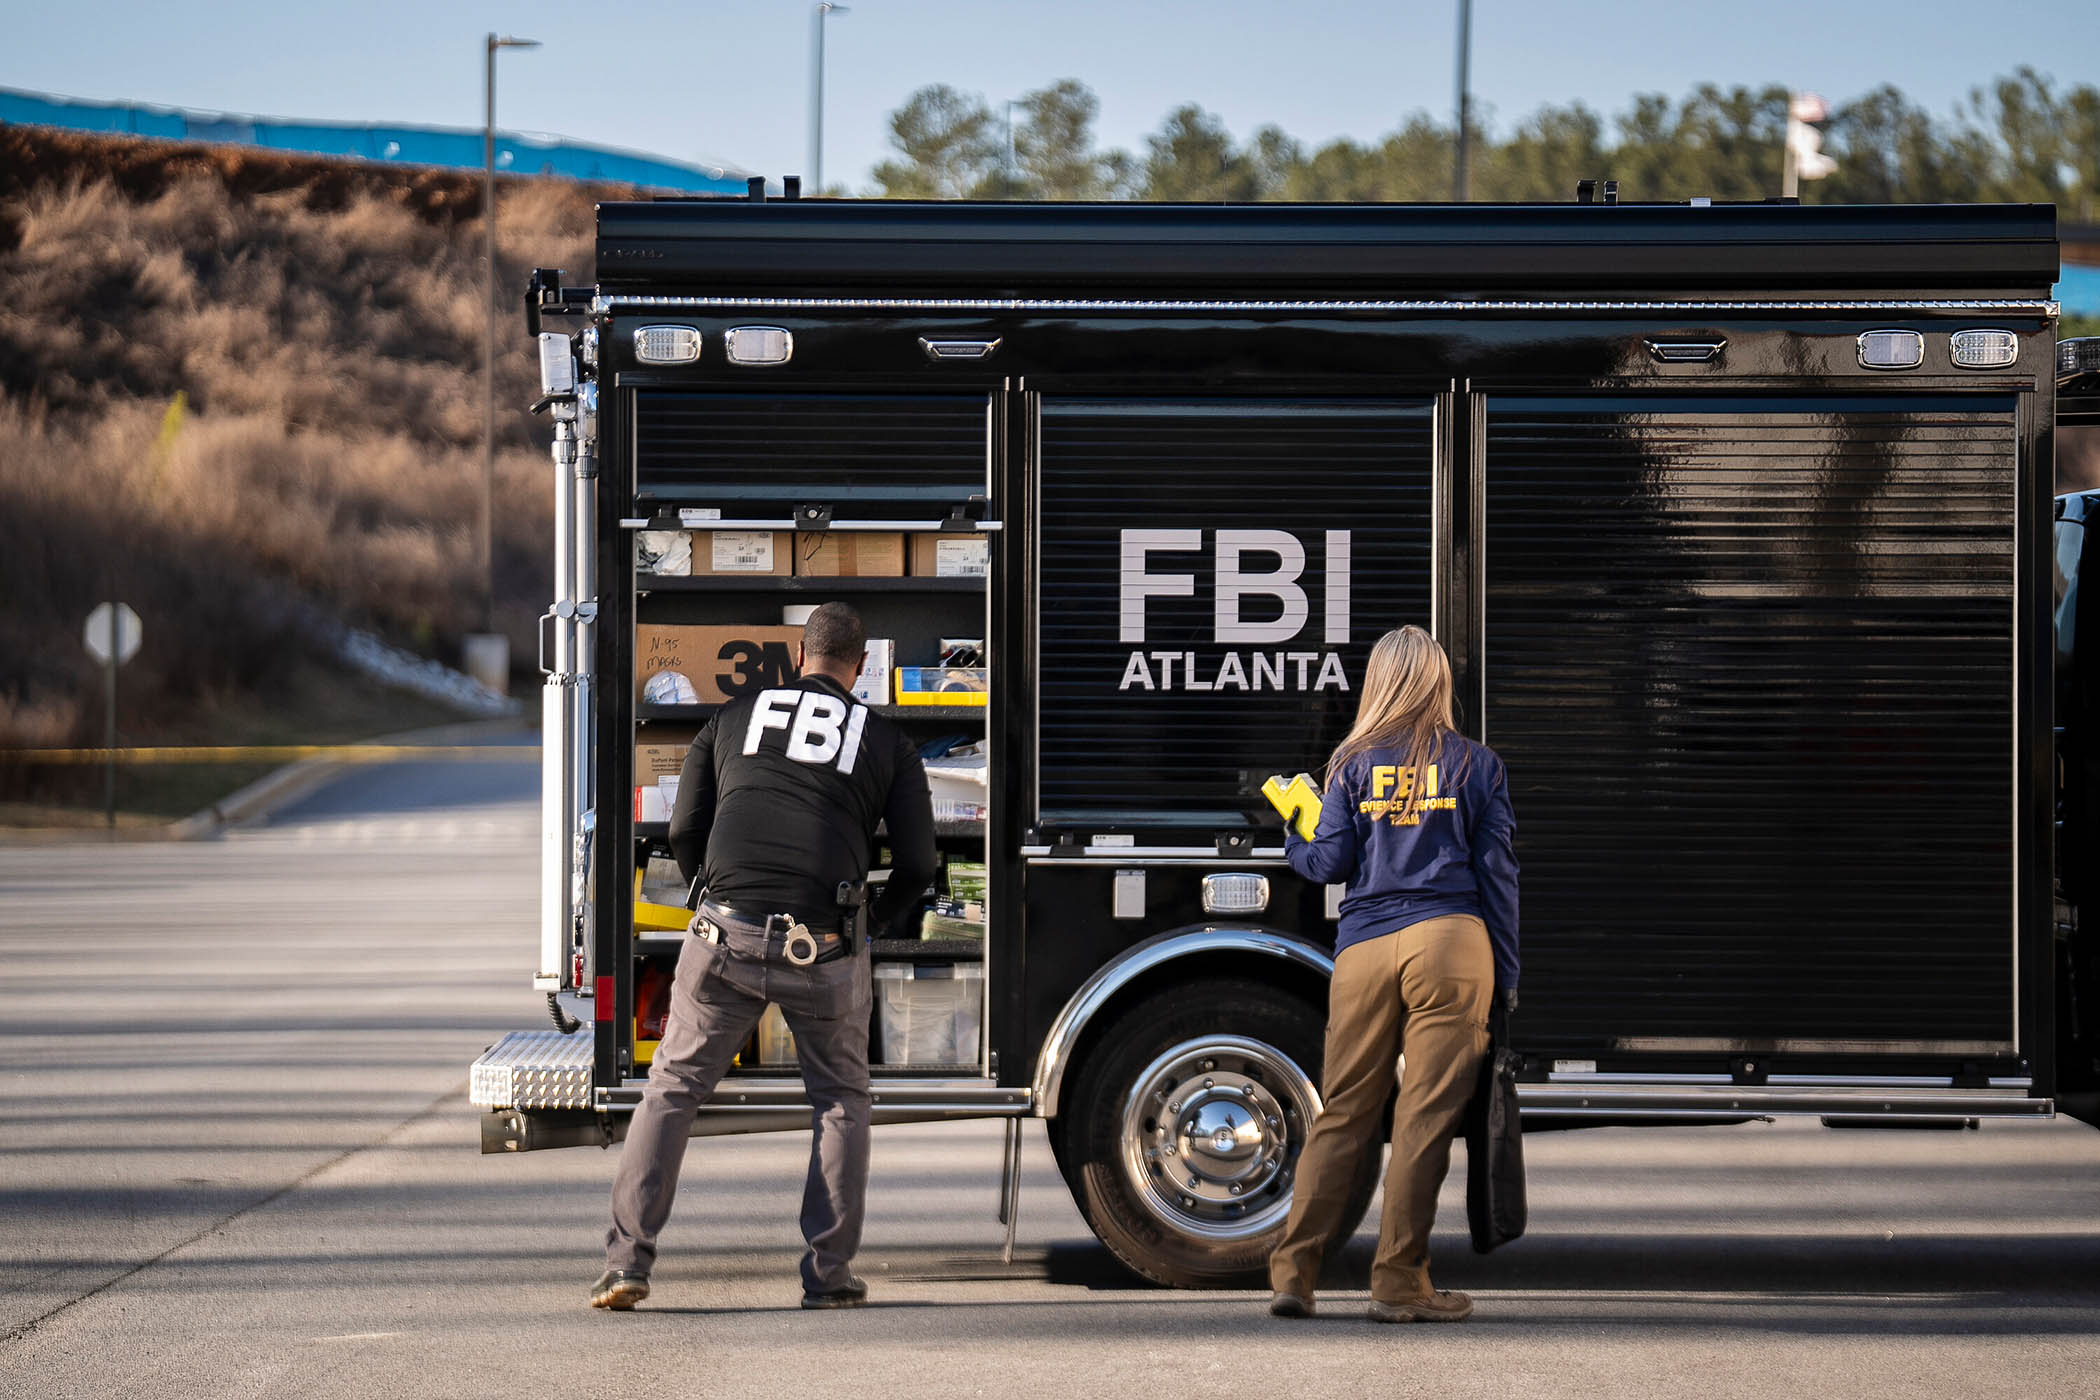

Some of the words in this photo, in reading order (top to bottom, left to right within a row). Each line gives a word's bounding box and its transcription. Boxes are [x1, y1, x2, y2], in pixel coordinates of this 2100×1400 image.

[1119, 528, 1351, 643] FBI
[1118, 651, 1350, 690] ATLANTA
[742, 690, 868, 775] FBI
[1406, 797, 1457, 811] ESPONSE
